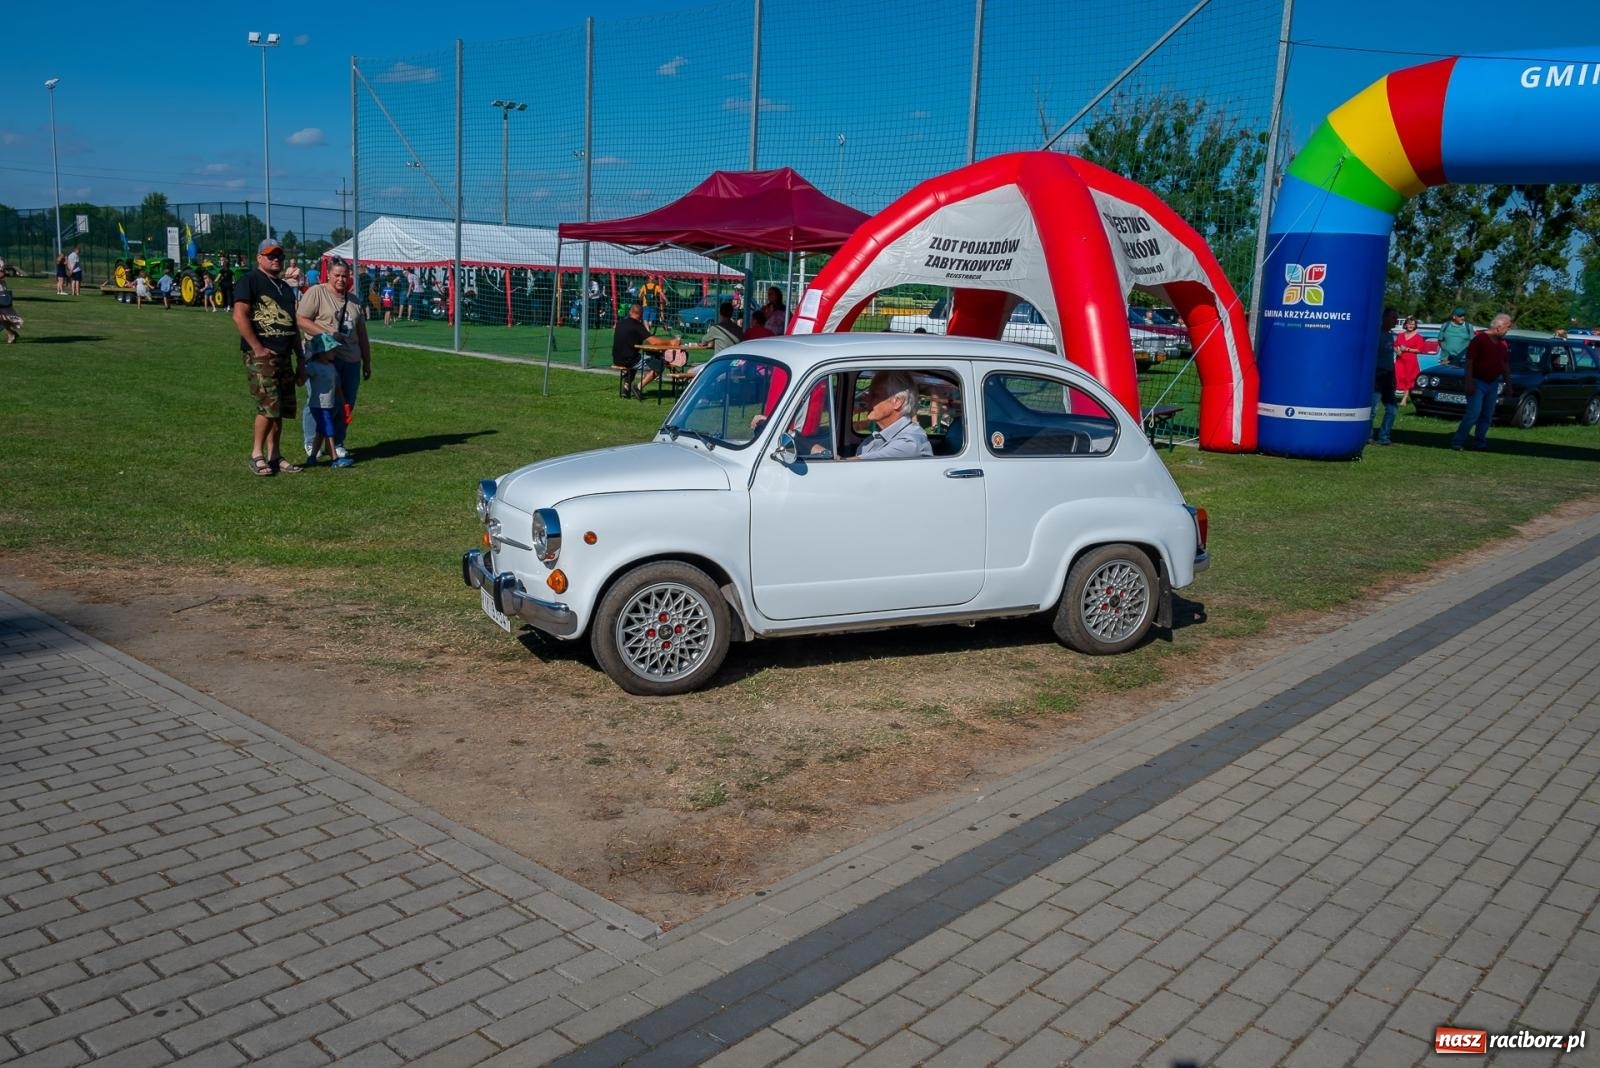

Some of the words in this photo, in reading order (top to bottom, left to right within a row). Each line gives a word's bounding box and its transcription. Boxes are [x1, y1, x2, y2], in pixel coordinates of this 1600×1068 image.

[929, 236, 960, 253] ZLOT
[959, 238, 1021, 255] POJAZDÓW
[924, 254, 1013, 272] ZABYTKOWYCH
[1264, 309, 1283, 318] GMINA
[1284, 309, 1351, 320] KRZYŻANOWICE
